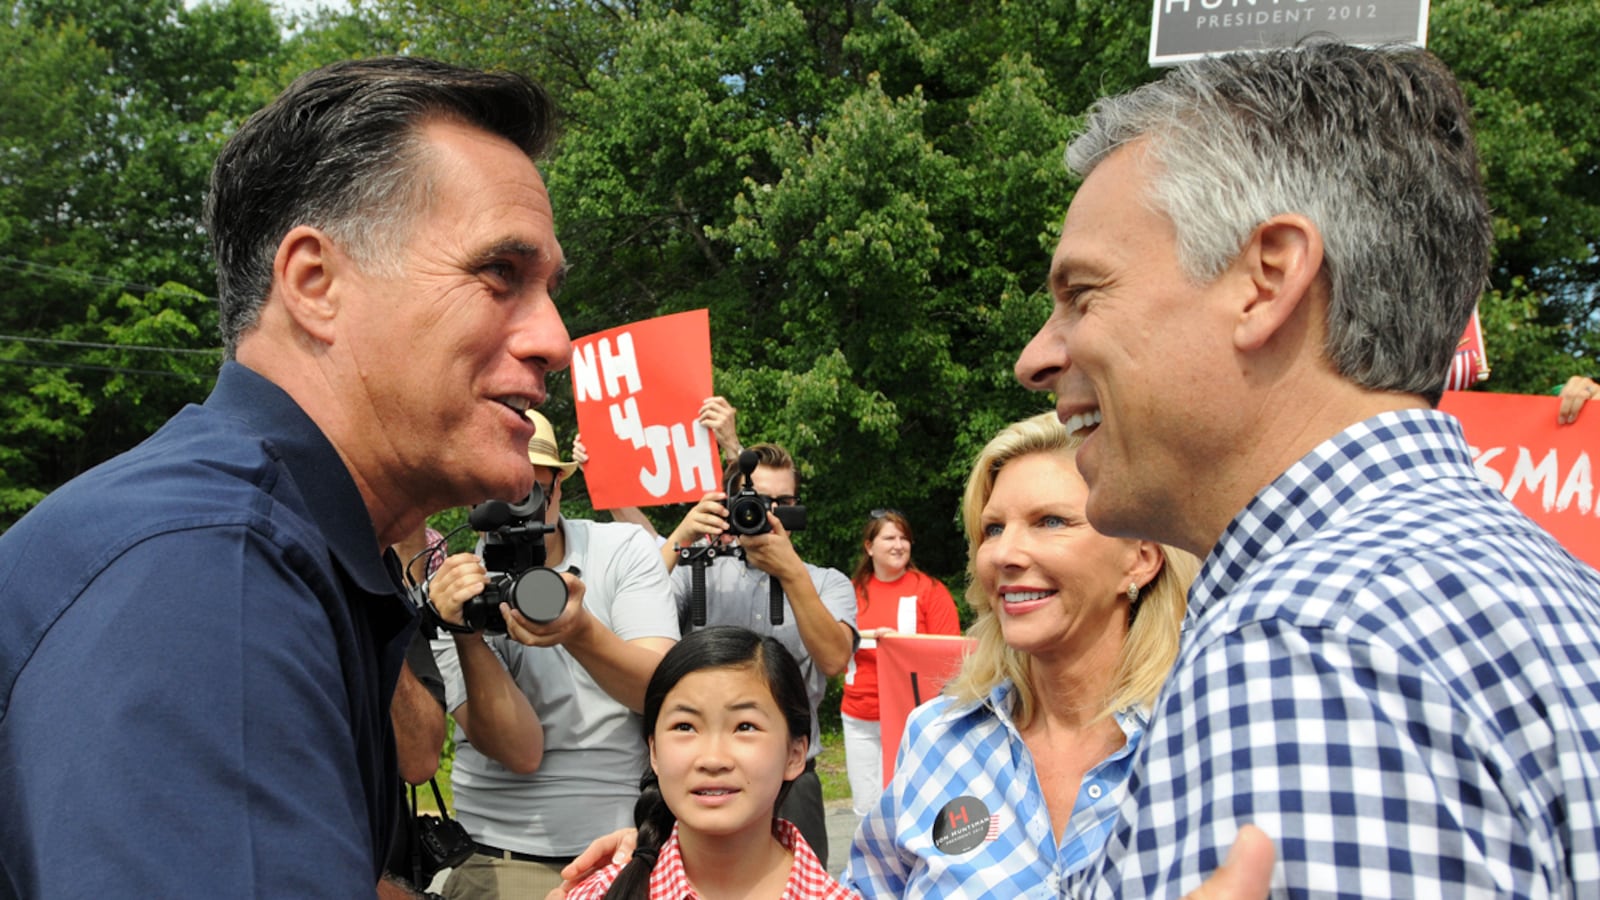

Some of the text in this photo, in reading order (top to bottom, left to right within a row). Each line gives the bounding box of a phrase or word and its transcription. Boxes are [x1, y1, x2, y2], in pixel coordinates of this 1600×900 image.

[1196, 7, 1316, 29] PRESIDENT
[1327, 3, 1377, 21] 2012
[572, 331, 642, 402] NH
[609, 396, 646, 450] 4
[639, 417, 717, 498] JH
[1469, 445, 1600, 518] SMA
[948, 805, 969, 829] H
[951, 817, 989, 836] HUNTSMAN
